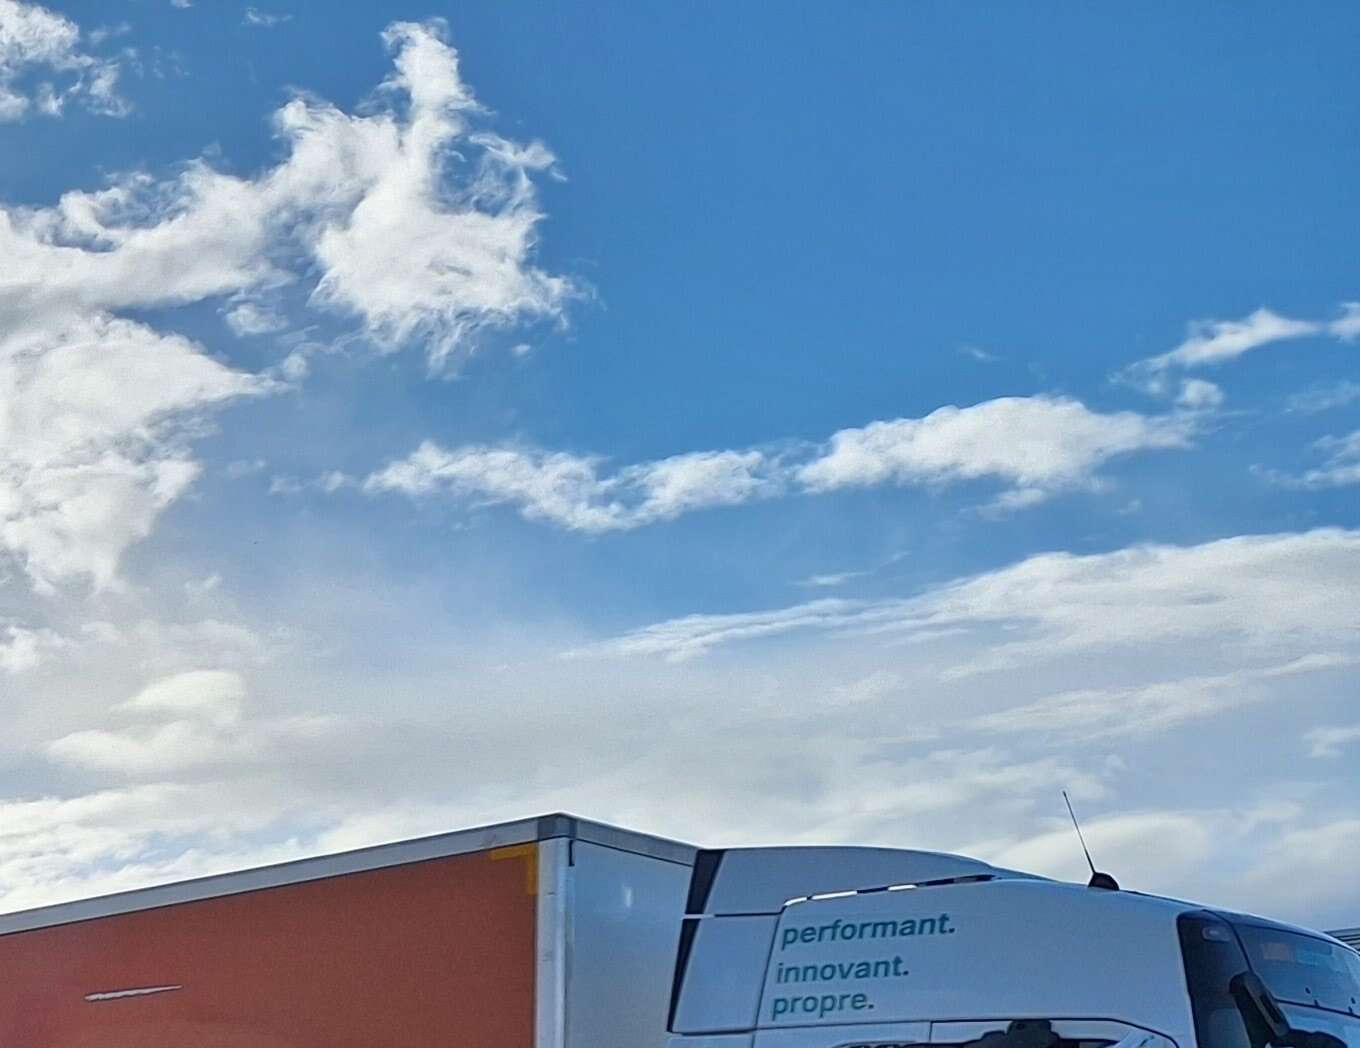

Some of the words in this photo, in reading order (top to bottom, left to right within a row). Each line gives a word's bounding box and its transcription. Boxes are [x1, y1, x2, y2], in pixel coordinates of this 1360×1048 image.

[781, 913, 956, 950] performant.
[776, 955, 910, 984] innovant.
[772, 992, 875, 1021] propre.
